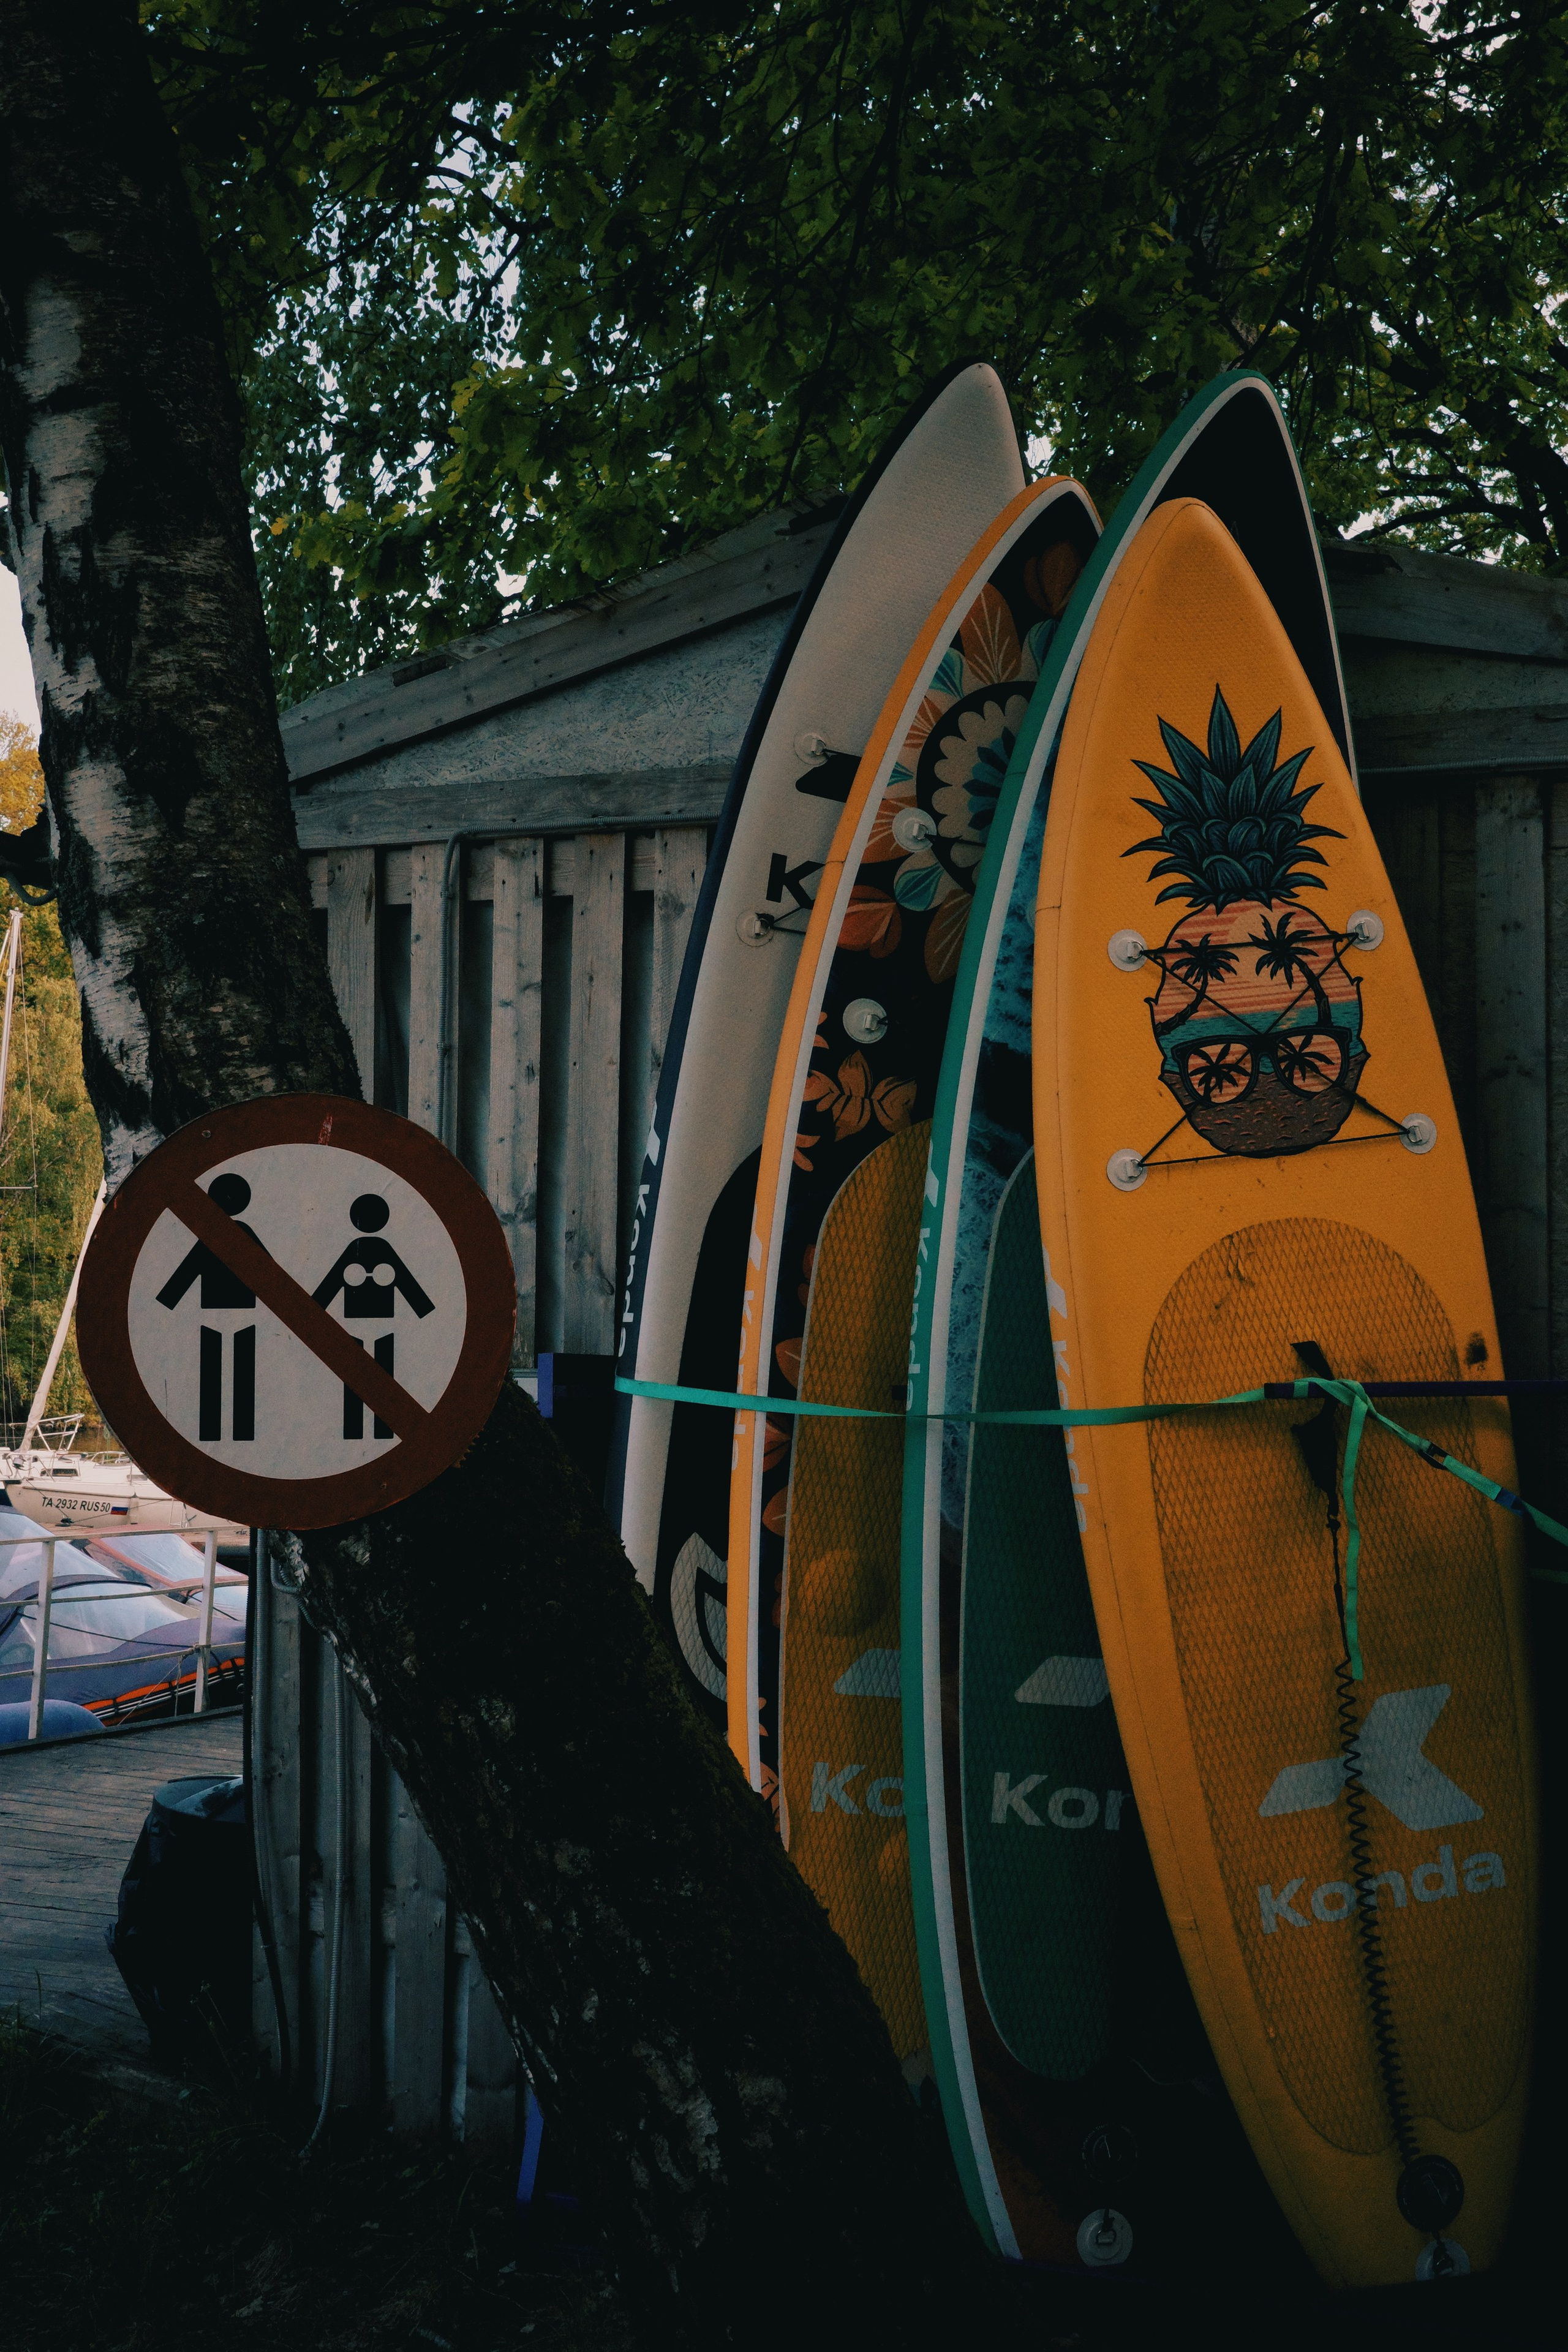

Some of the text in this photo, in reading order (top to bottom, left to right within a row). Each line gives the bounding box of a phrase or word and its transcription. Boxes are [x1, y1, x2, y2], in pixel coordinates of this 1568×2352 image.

[42, 1497, 53, 1507] TA
[55, 1498, 78, 1510] 2932
[1257, 1844, 1507, 1935] Konda
